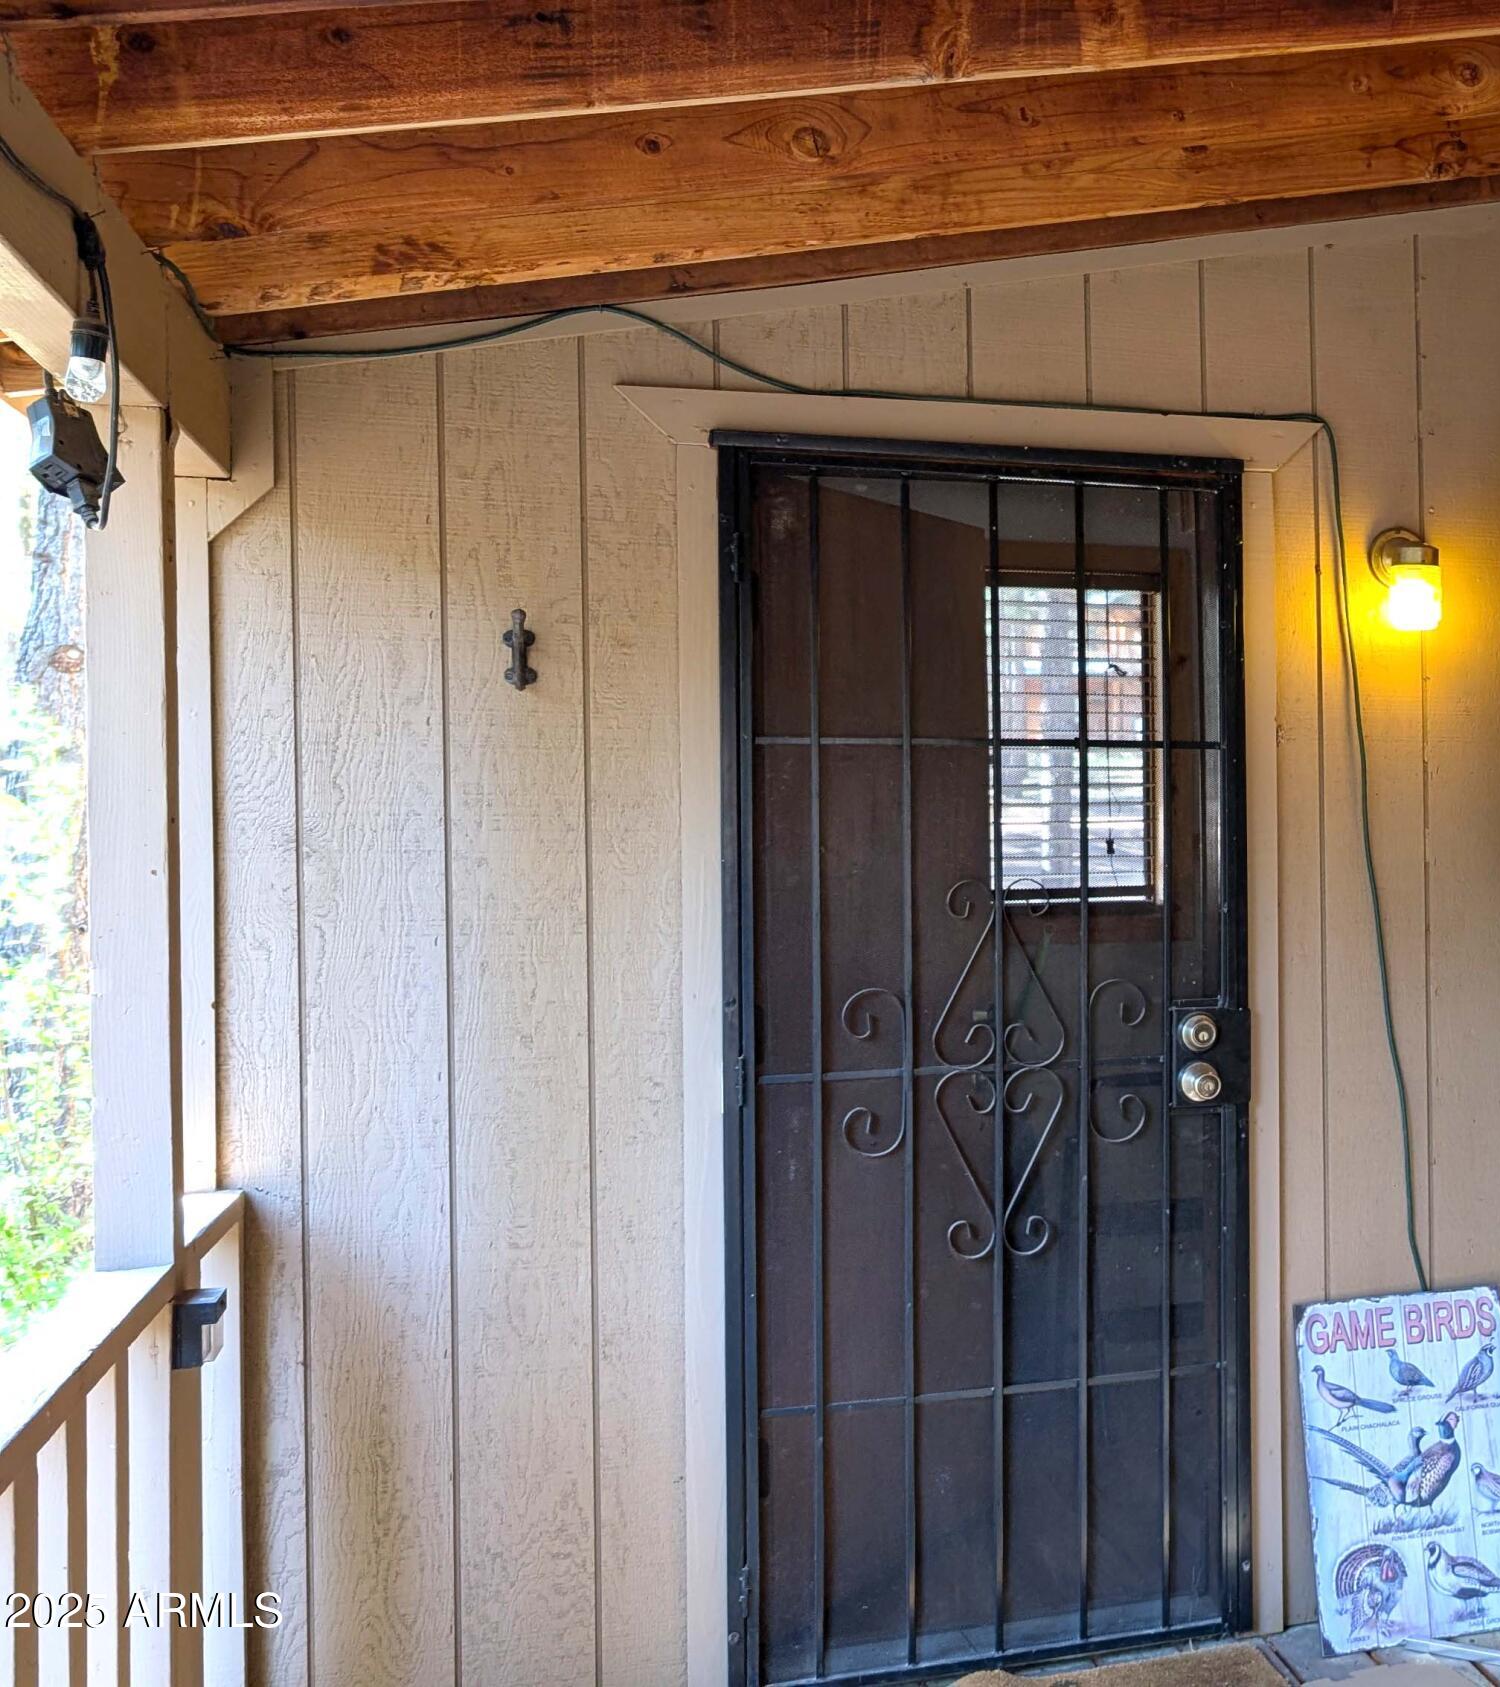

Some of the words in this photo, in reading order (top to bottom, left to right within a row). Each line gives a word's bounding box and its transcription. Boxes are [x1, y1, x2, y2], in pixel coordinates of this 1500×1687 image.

[1305, 1306, 1397, 1355] GAME
[1403, 1296, 1497, 1344] BIRDS
[1454, 1402, 1488, 1412] CALIFORNIA
[1341, 1425, 1359, 1433] PLAIN
[1360, 1420, 1400, 1430] CHACHALACA
[1346, 1635, 1370, 1644] TURKEY
